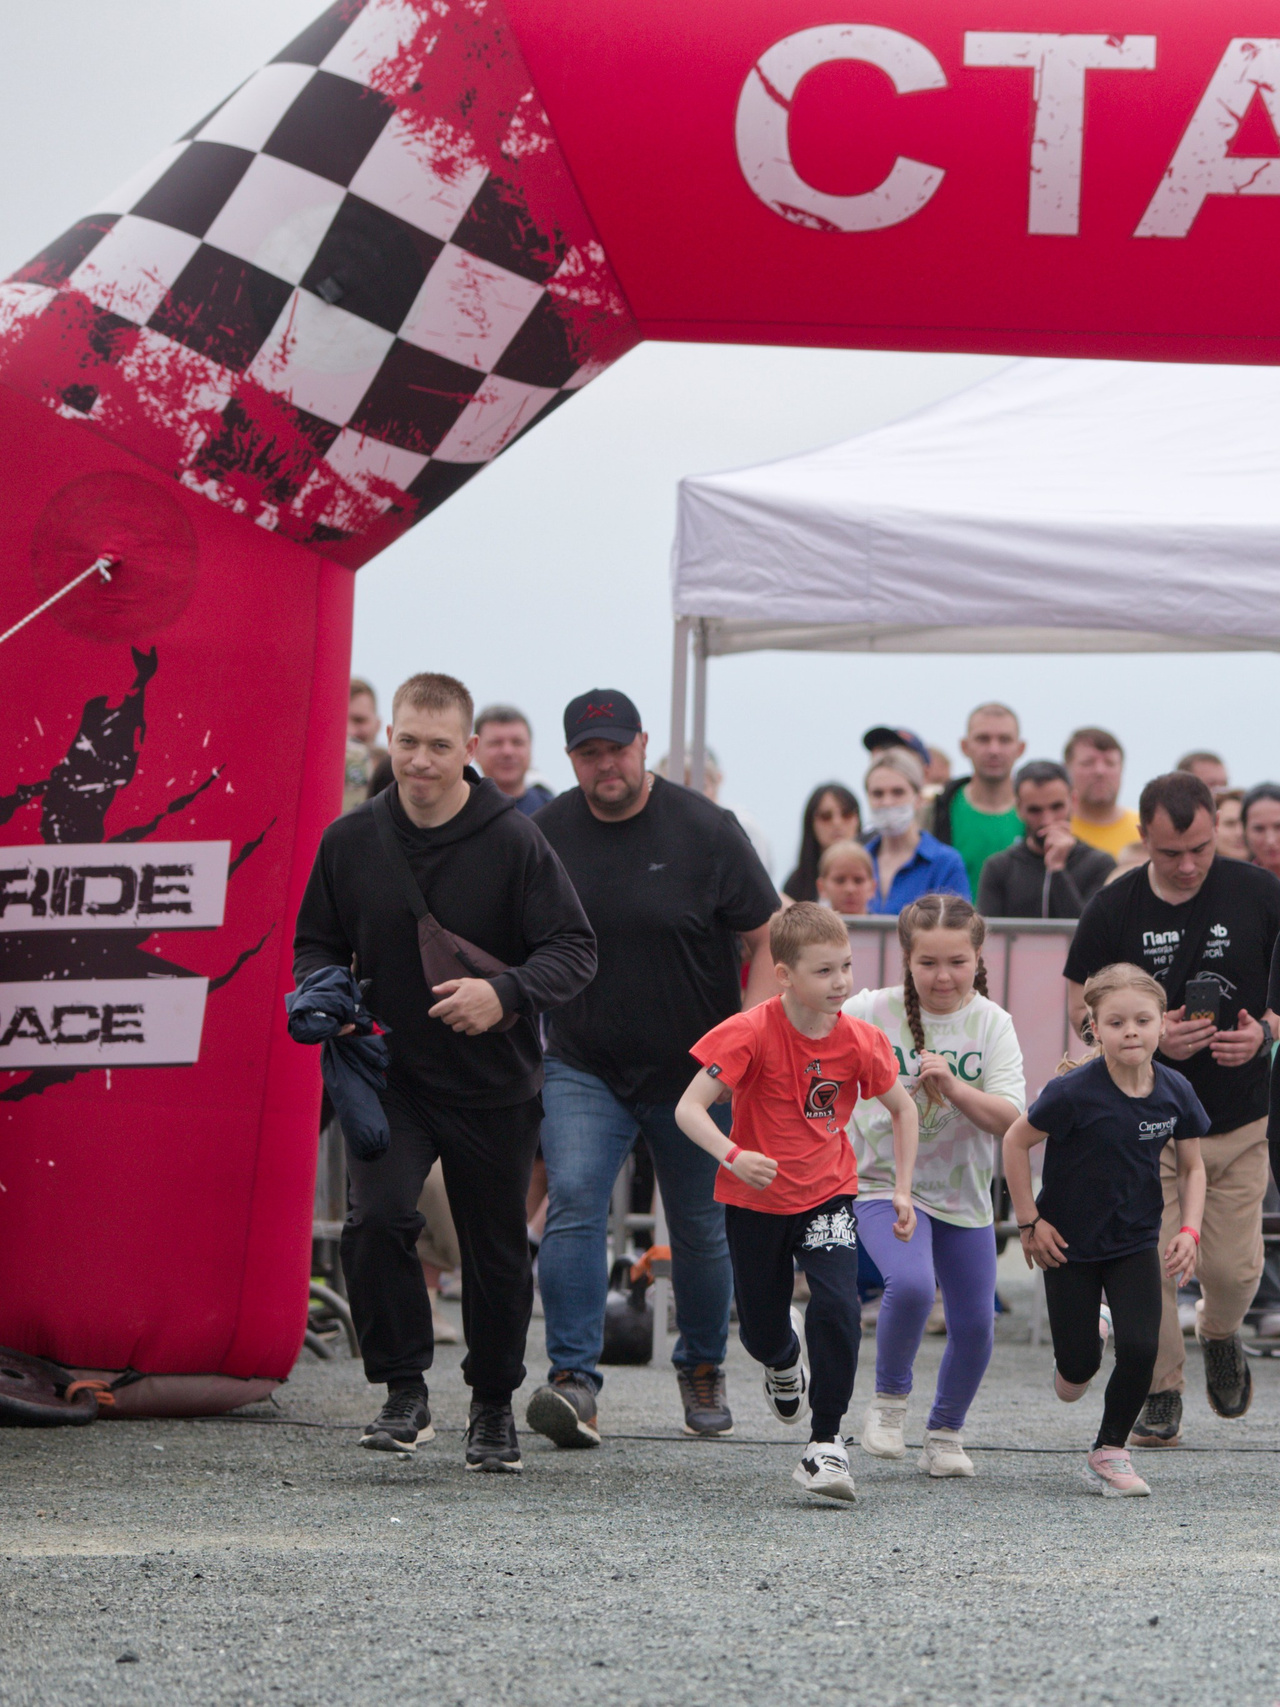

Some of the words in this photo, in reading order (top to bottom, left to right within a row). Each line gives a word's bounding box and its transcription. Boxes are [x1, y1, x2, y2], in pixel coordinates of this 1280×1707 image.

[0, 862, 194, 918] RIDE
[1142, 930, 1180, 947] Папа
[0, 1003, 145, 1047] ACE
